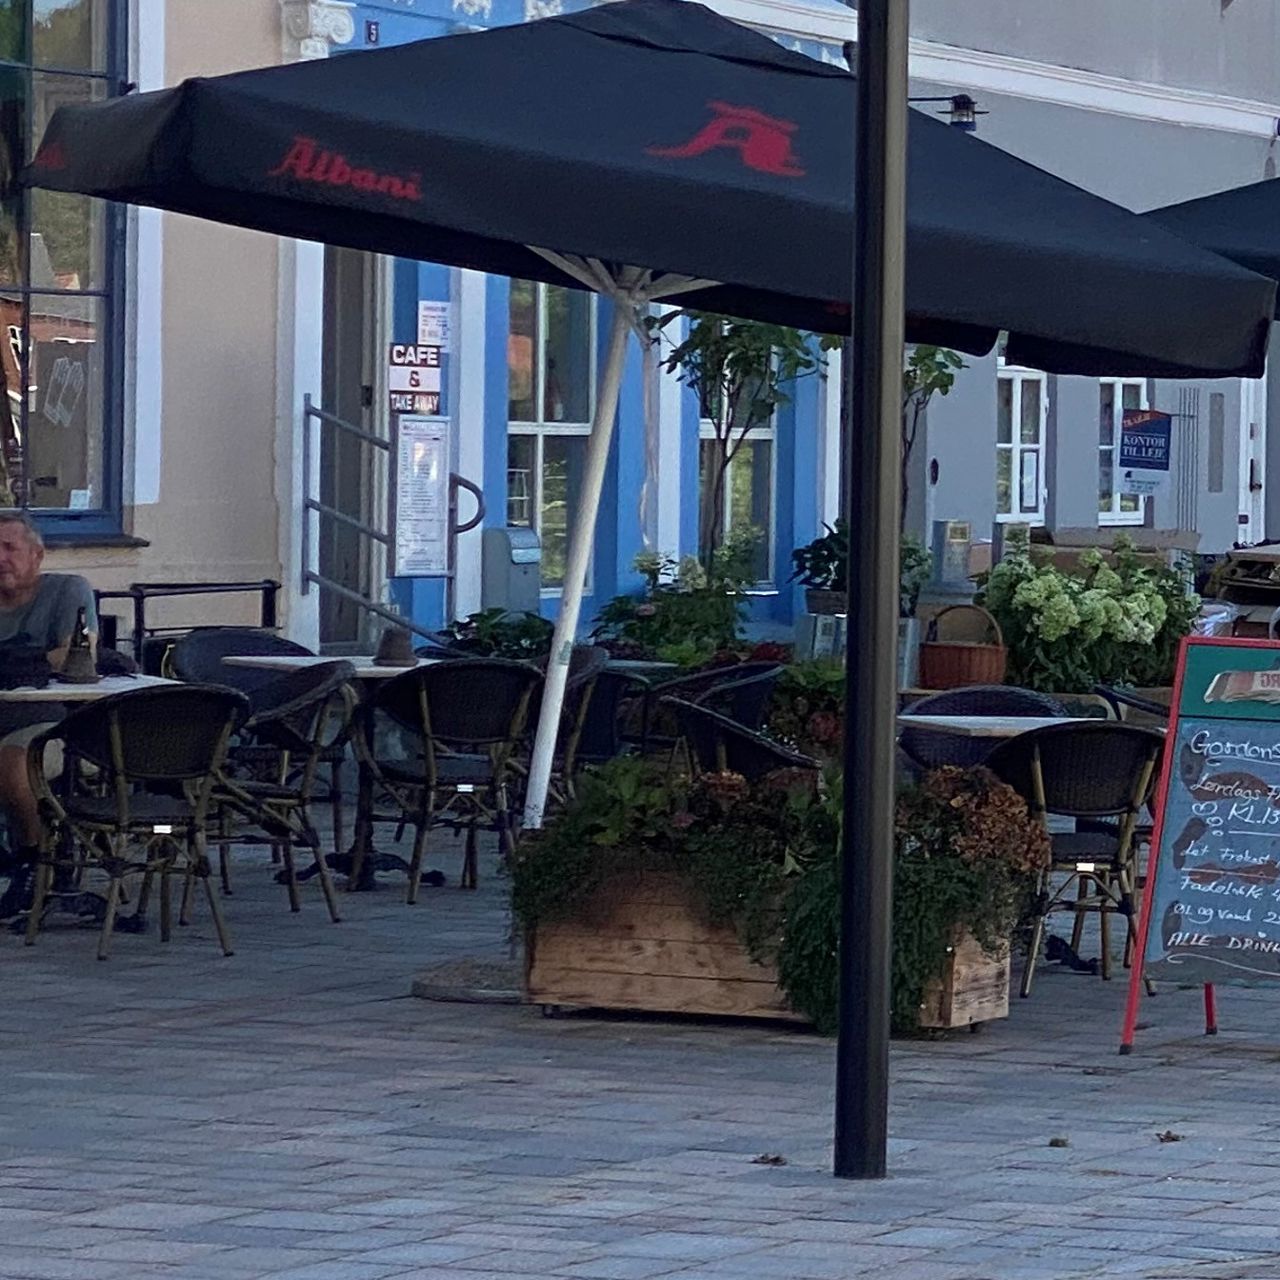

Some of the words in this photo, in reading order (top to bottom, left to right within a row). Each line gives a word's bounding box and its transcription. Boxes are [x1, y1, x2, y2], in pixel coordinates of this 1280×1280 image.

[267, 133, 423, 201] Albani
[392, 345, 438, 365] CAFE
[409, 370, 420, 388] &
[390, 394, 413, 411] TAKE
[413, 394, 439, 411] AWAY
[1123, 435, 1166, 448] KONTOR
[1167, 931, 1212, 947] ALLE
